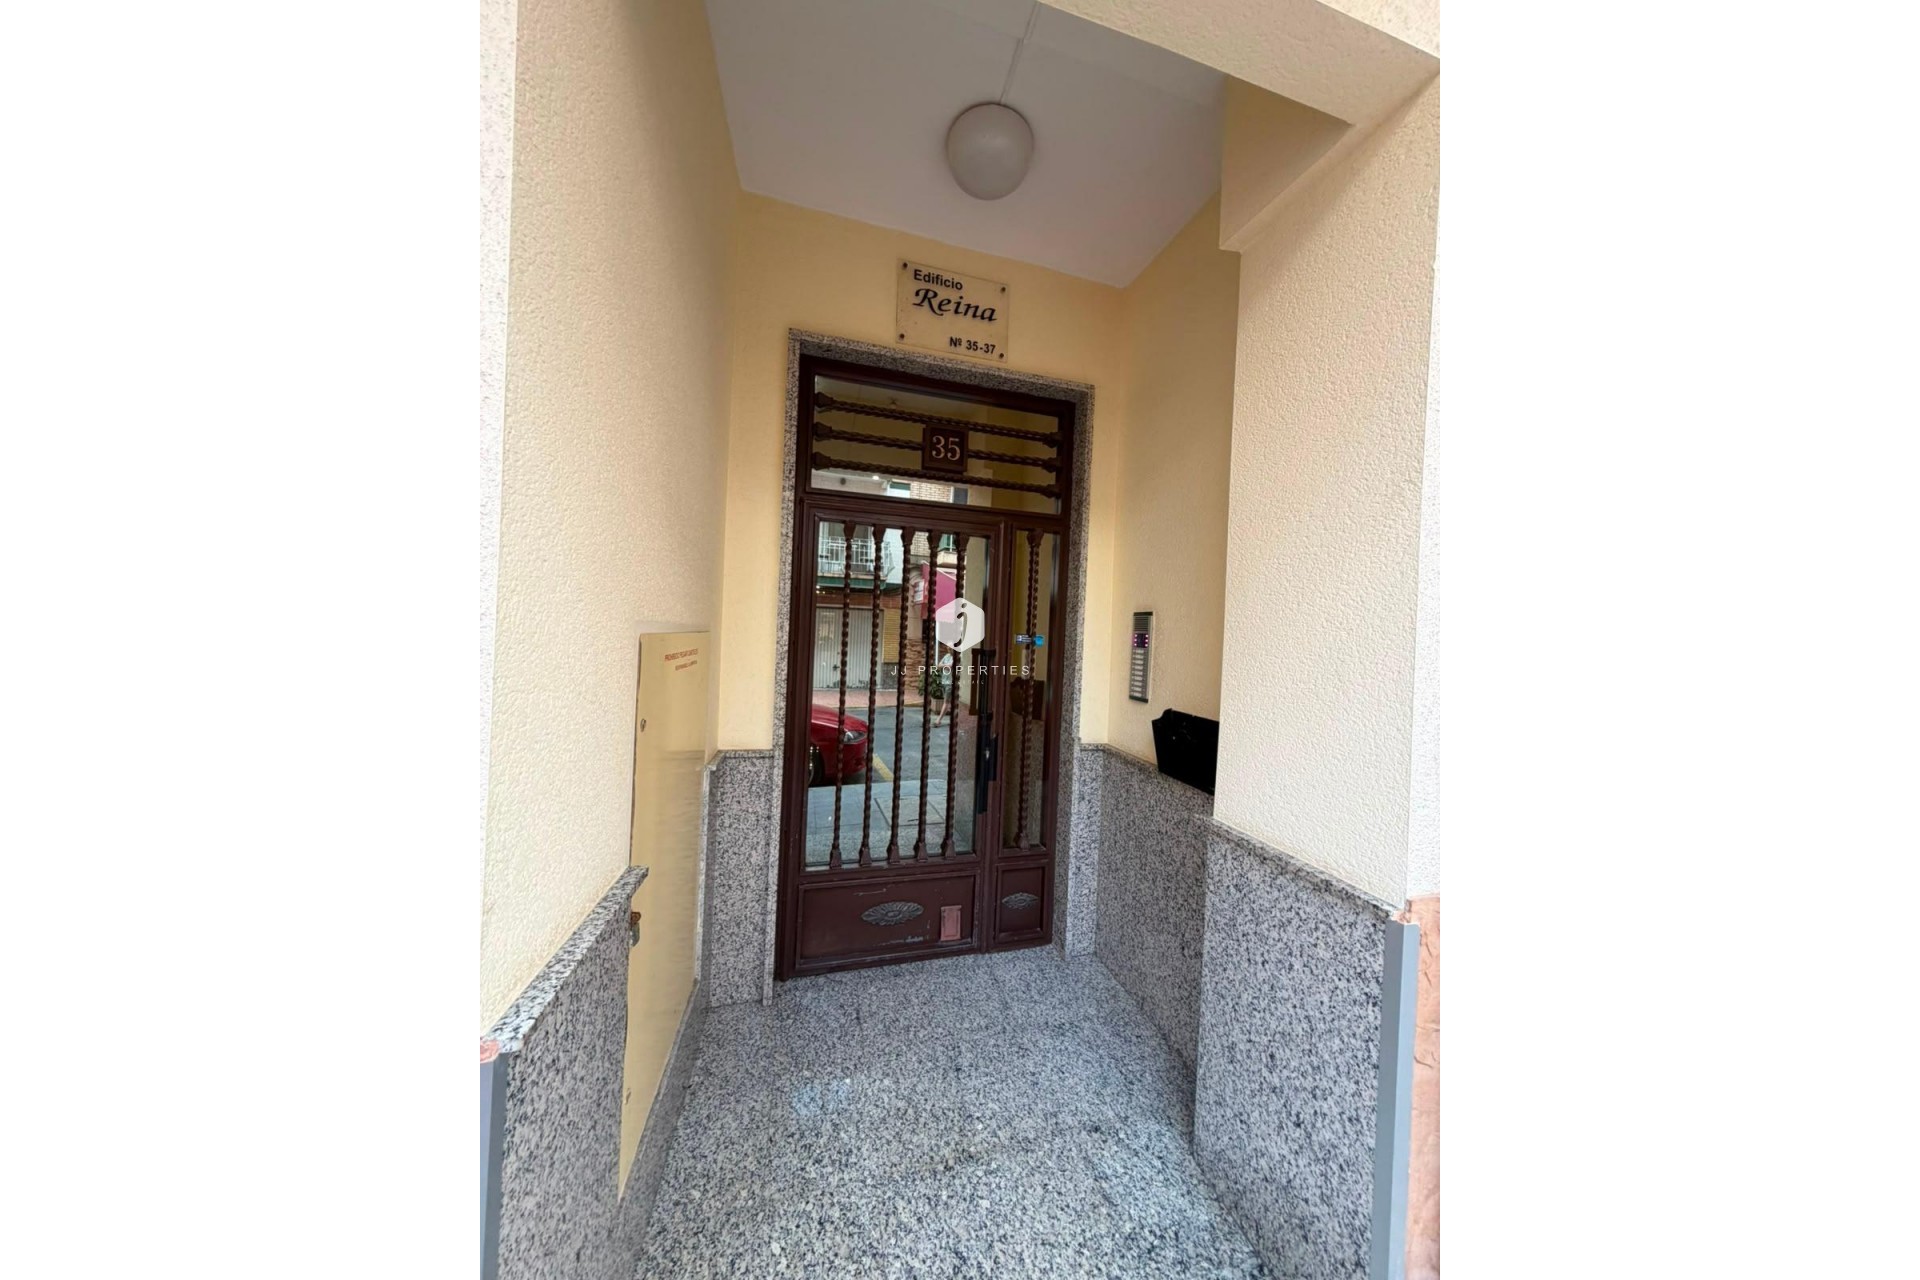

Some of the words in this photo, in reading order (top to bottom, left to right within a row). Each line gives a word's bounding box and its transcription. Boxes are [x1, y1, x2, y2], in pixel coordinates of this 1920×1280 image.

[913, 269, 963, 290] Edificio
[912, 288, 997, 322] Reina
[966, 340, 996, 354] 35-37
[932, 435, 960, 461] 35
